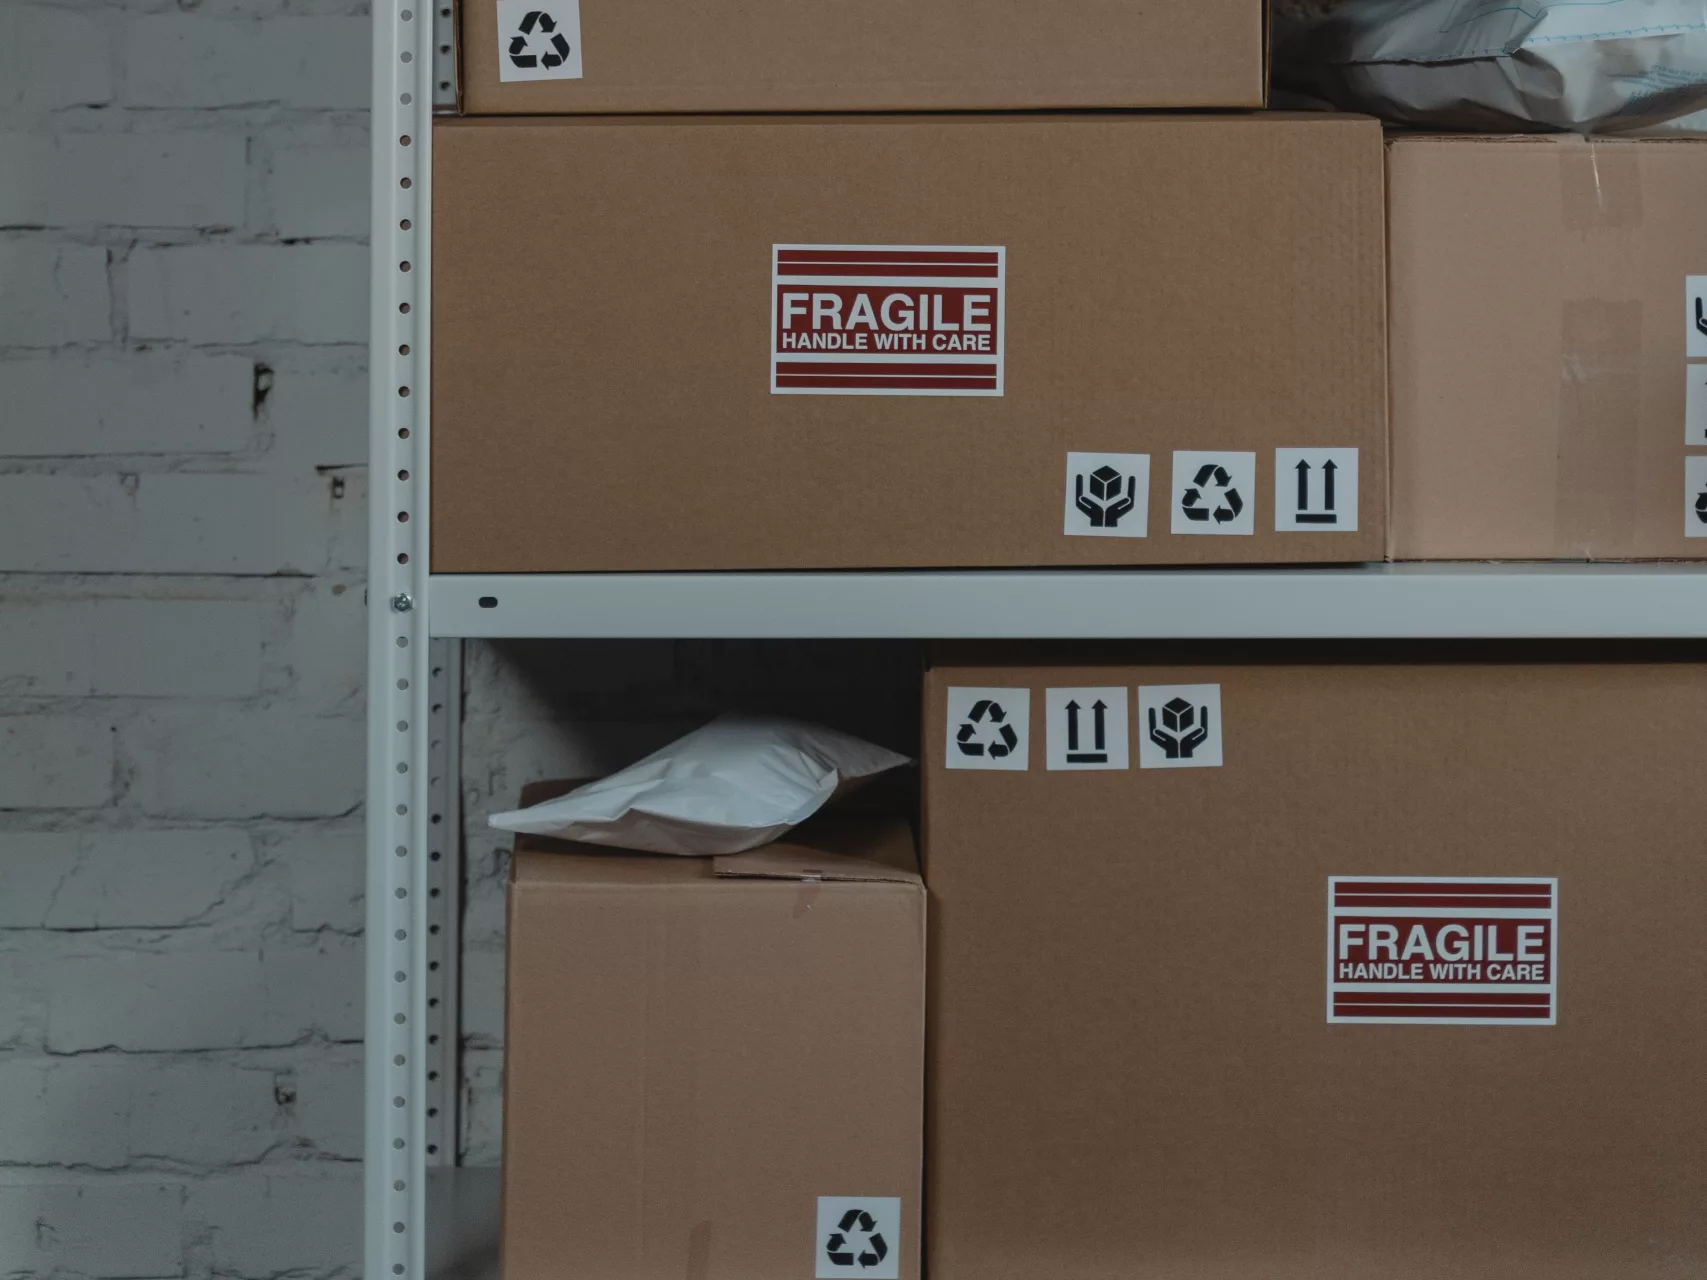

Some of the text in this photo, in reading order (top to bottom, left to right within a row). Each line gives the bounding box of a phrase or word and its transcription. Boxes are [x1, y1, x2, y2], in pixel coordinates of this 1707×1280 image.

[782, 292, 991, 332] FRAGILE
[782, 332, 991, 351] HANDLE WITH CARE
[1339, 923, 1545, 962] FRAGILE
[1339, 962, 1545, 981] HANDLE WITH CARE
